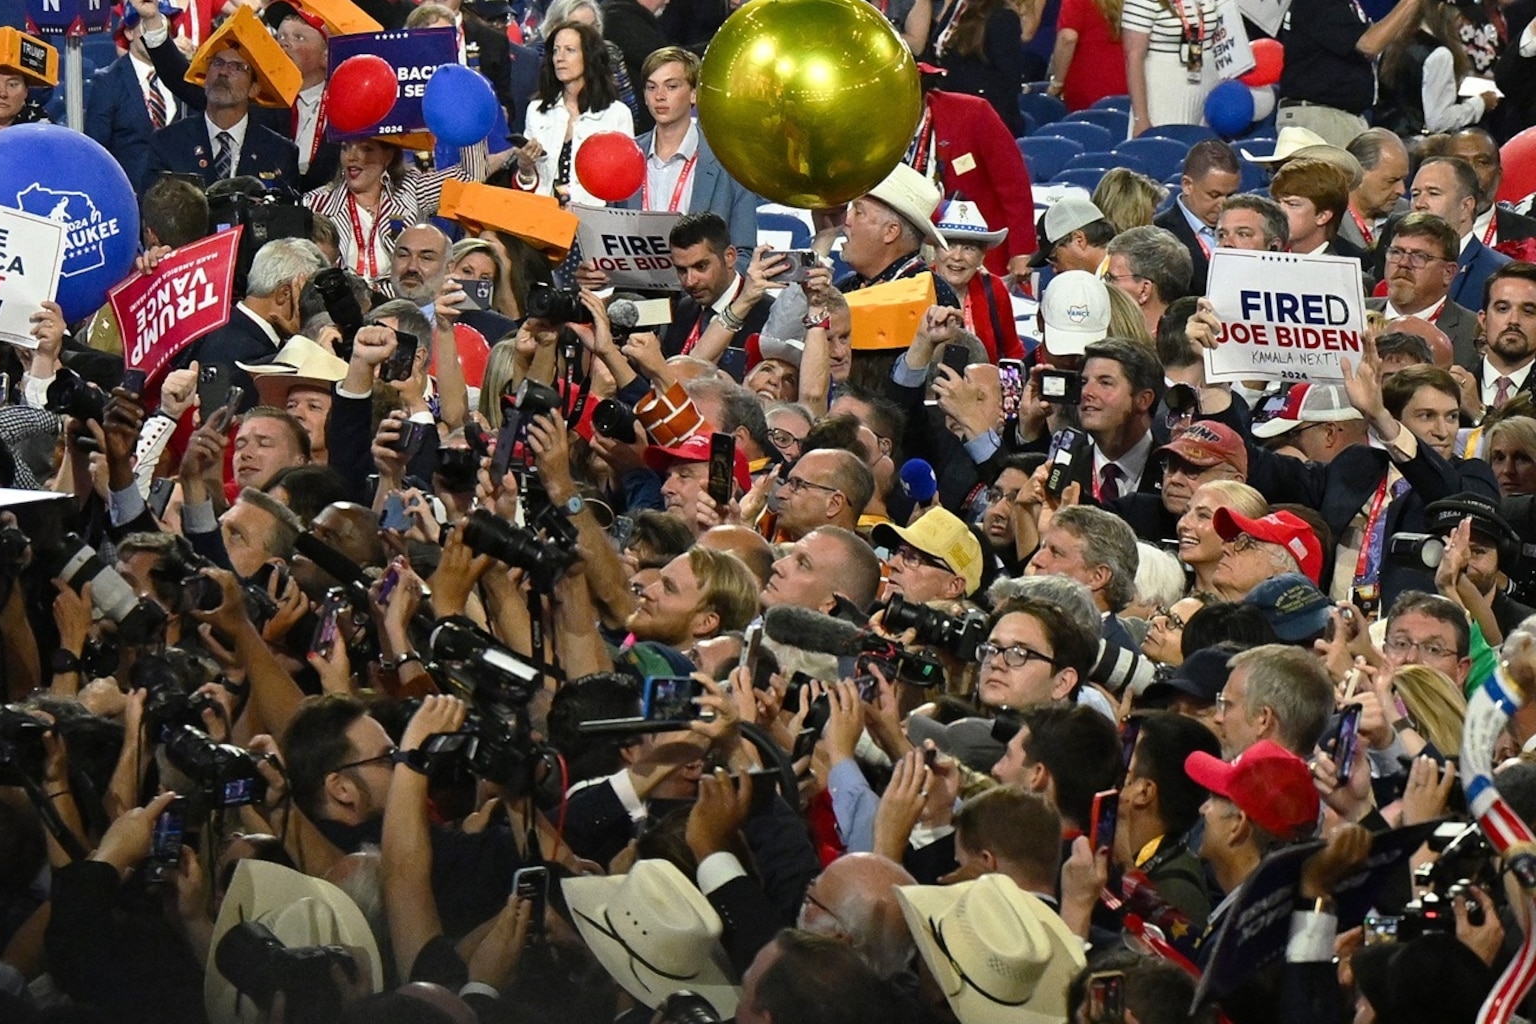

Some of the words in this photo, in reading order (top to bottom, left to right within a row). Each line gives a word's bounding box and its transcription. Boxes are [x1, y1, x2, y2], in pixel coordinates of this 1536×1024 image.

[22, 41, 46, 60] TRUMP
[378, 125, 403, 134] 2024
[64, 218, 88, 232] 024
[64, 218, 120, 250] AUKEE
[195, 252, 218, 266] MAKE
[633, 257, 673, 271] BID
[161, 262, 196, 280] AMERICA
[136, 267, 208, 334] VANCE
[1240, 290, 1350, 326] FIRED
[1066, 309, 1090, 317] VANCE
[131, 282, 219, 366] TRUMP
[1215, 322, 1269, 346] JOE
[1275, 326, 1360, 352] BIDEN
[1251, 350, 1294, 365] KAMALA
[1299, 351, 1339, 366] NEXT!
[1280, 370, 1308, 380] 2024
